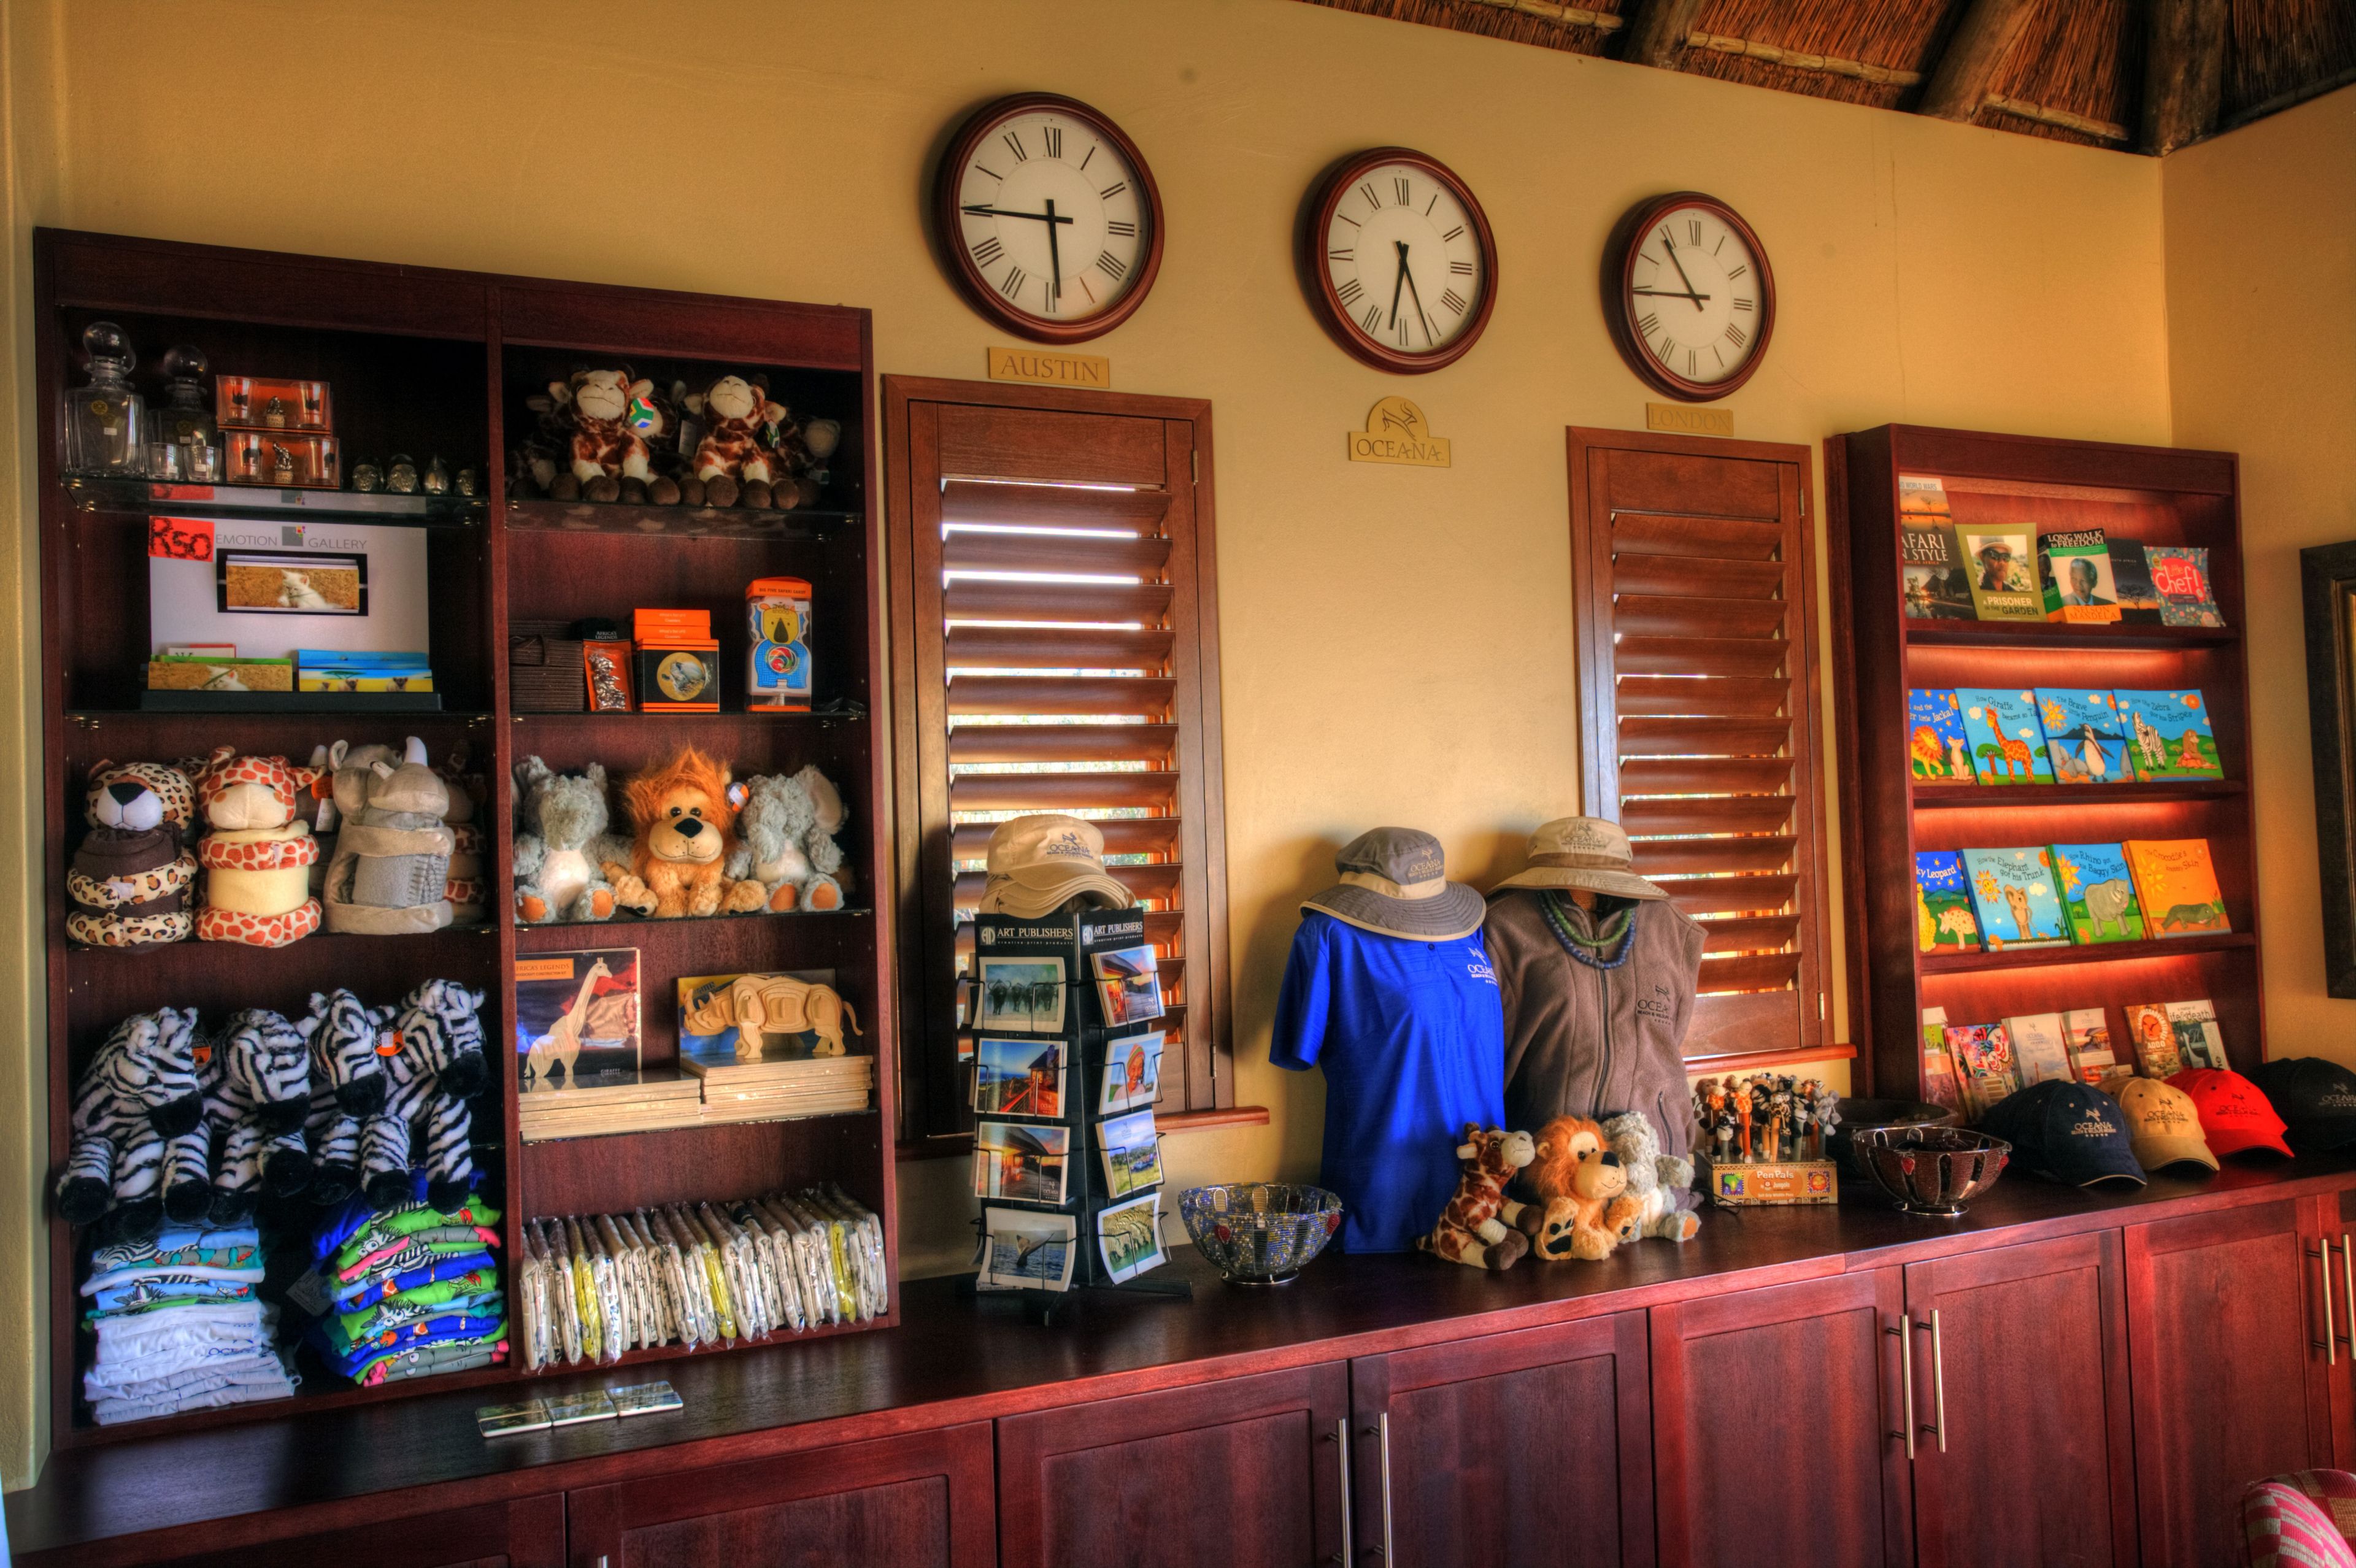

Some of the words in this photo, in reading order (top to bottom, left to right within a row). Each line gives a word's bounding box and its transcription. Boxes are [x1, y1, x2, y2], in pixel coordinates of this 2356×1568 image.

[1001, 355, 1099, 382] AUSTIN
[1650, 407, 1731, 431] LONDON
[215, 534, 277, 546] EMOTION
[309, 538, 367, 550] GALLERY
[2048, 534, 2072, 542] LONG
[2074, 531, 2101, 540] WALK
[2057, 538, 2104, 548] FREEDOM
[1912, 549, 1949, 561] STYLE
[1987, 596, 2033, 606] PRISONER
[2002, 606, 2038, 615] GARDEN
[1988, 696, 2013, 710] Giraffe
[2068, 698, 2087, 711] Brave
[2151, 702, 2170, 712] Zebra
[1932, 707, 1954, 723] Jackal
[2082, 711, 2109, 724] Penguin
[2168, 711, 2192, 723] Stripes
[1050, 844, 1090, 853] OCEANA
[2079, 851, 2101, 864] Rhino
[1411, 859, 1441, 872] OCEANA
[1997, 857, 2029, 872] Elephant
[2088, 864, 2109, 877] Baggy
[2111, 862, 2125, 874] Skin
[2182, 859, 2200, 870] Skin
[1927, 864, 1956, 880] Leopard
[2012, 872, 2022, 881] his
[2023, 867, 2045, 880] Trunk
[998, 928, 1015, 937] ART
[1018, 928, 1073, 937] PUBLISHERS
[1094, 925, 1106, 935] ART
[1107, 922, 1143, 934] PUBLISHERS
[1638, 999, 1668, 1012] OCEA
[2074, 1121, 2112, 1131] OCEANA
